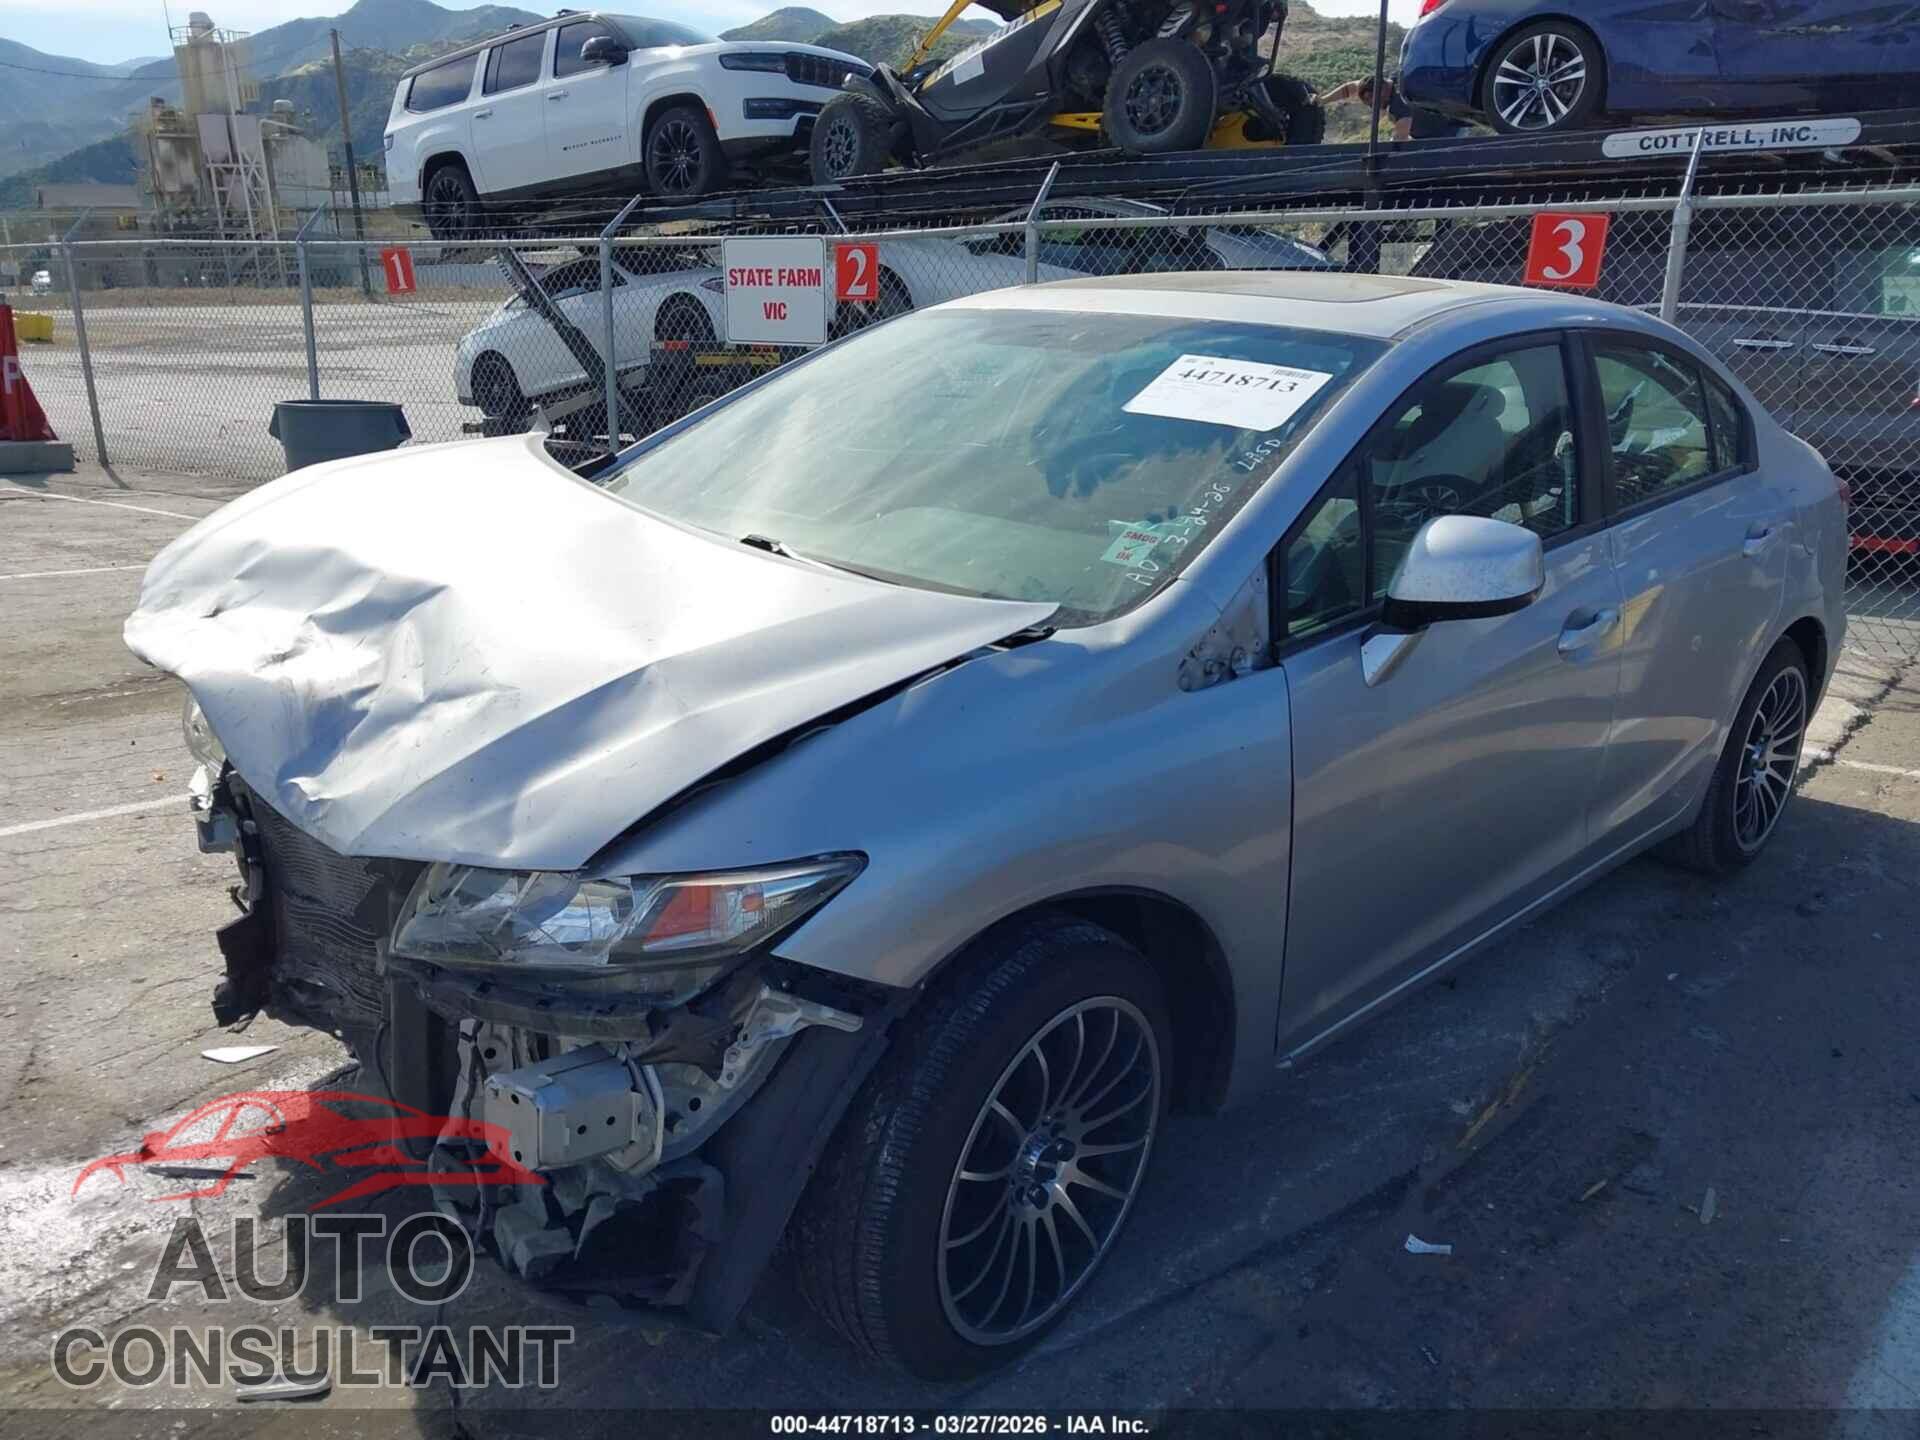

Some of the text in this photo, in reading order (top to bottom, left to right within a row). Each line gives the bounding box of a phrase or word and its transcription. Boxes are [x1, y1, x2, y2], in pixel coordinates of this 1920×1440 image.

[1639, 126, 1817, 151] COTTRELL, INC.
[1543, 219, 1586, 279] 3
[390, 253, 409, 289] 1
[729, 268, 821, 287] STATE FARM
[846, 248, 868, 296] 2
[763, 302, 787, 320] VIC
[1178, 367, 1299, 393] 44718713
